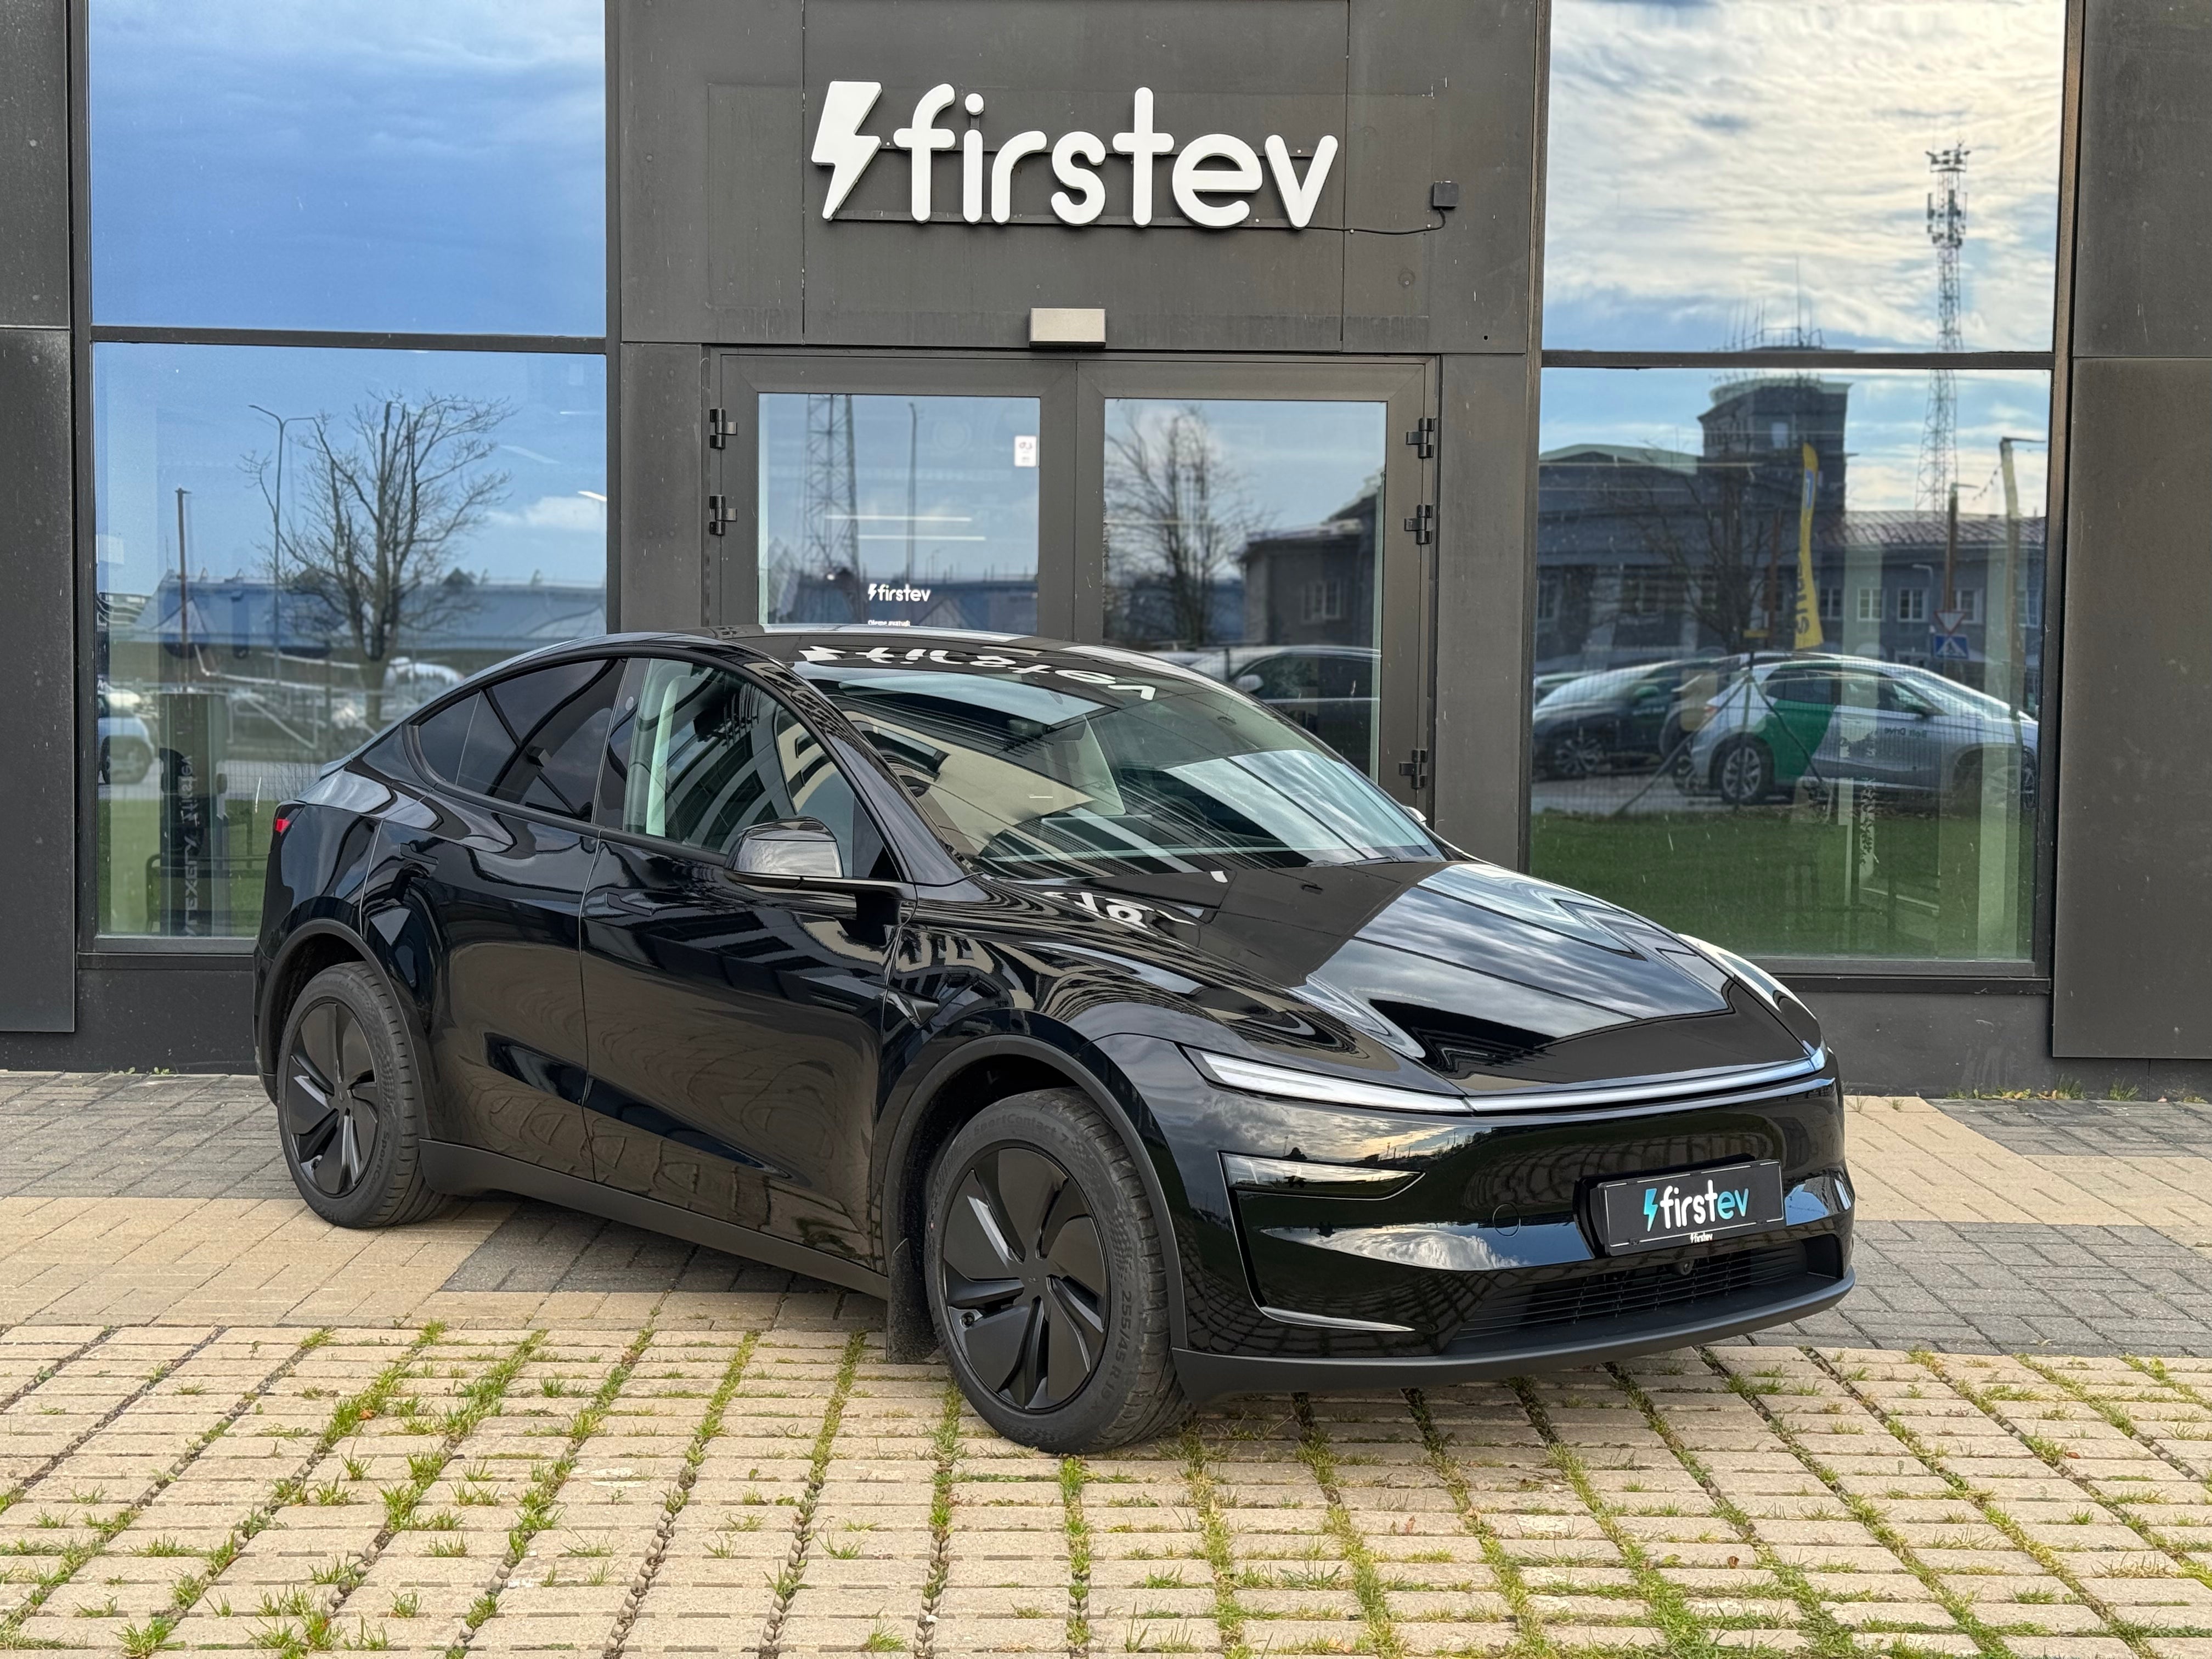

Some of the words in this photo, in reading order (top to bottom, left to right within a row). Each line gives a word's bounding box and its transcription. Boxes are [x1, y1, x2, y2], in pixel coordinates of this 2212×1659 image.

[893, 84, 1338, 228] firstev
[878, 584, 930, 601] firstev
[1660, 1180, 1749, 1229] firstev
[1116, 1290, 1132, 1363] 255/45
